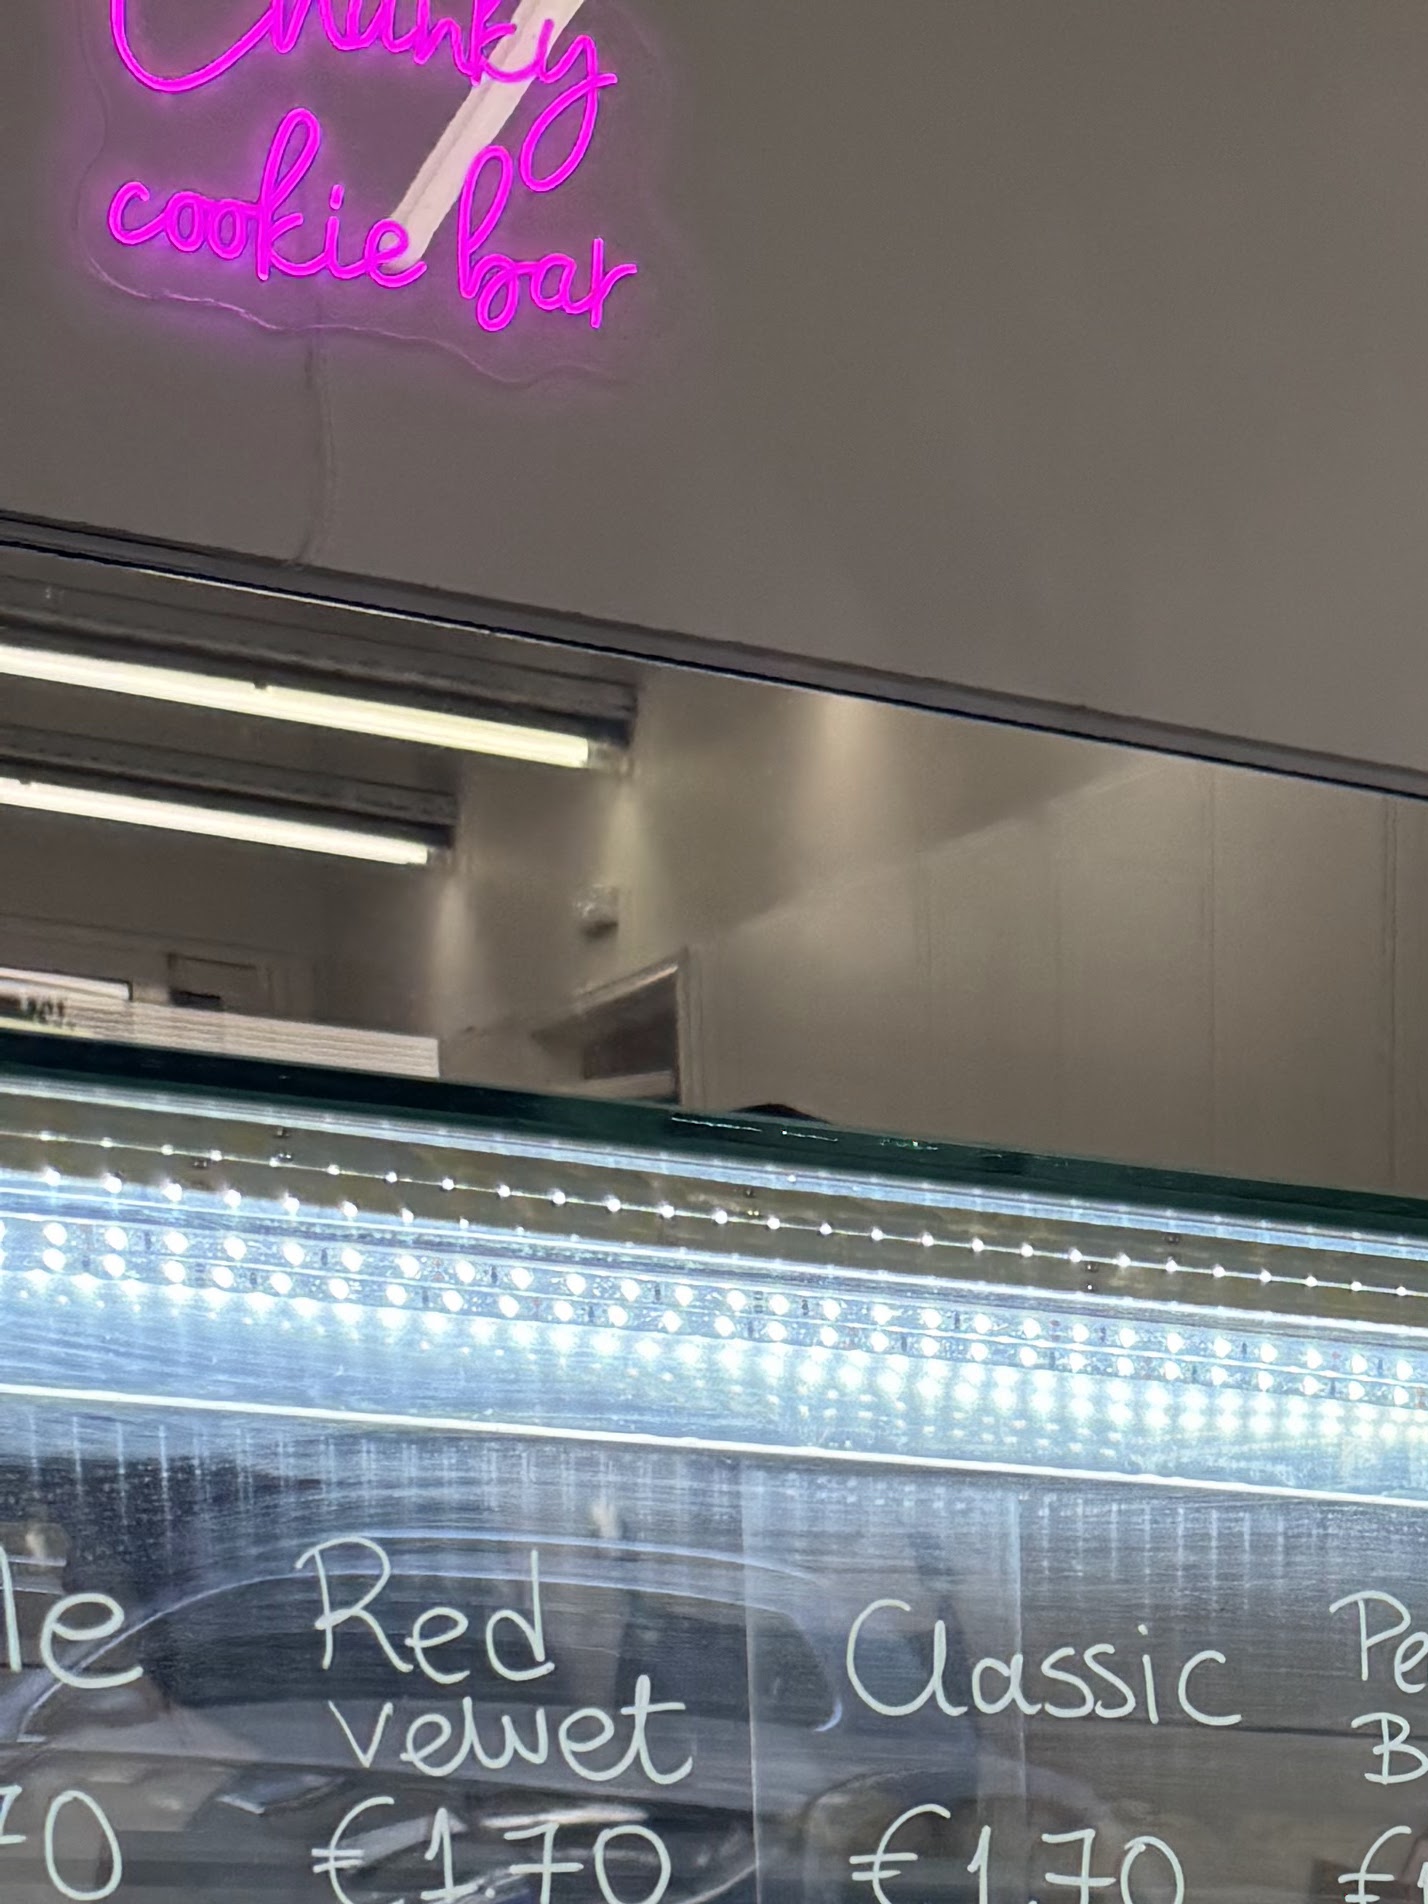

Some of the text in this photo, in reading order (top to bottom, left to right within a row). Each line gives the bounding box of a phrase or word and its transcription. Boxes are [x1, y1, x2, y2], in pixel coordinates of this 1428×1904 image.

[108, 107, 638, 332] cookie bar
[295, 1536, 555, 1686] Red
[846, 1597, 1242, 1727] Classic
